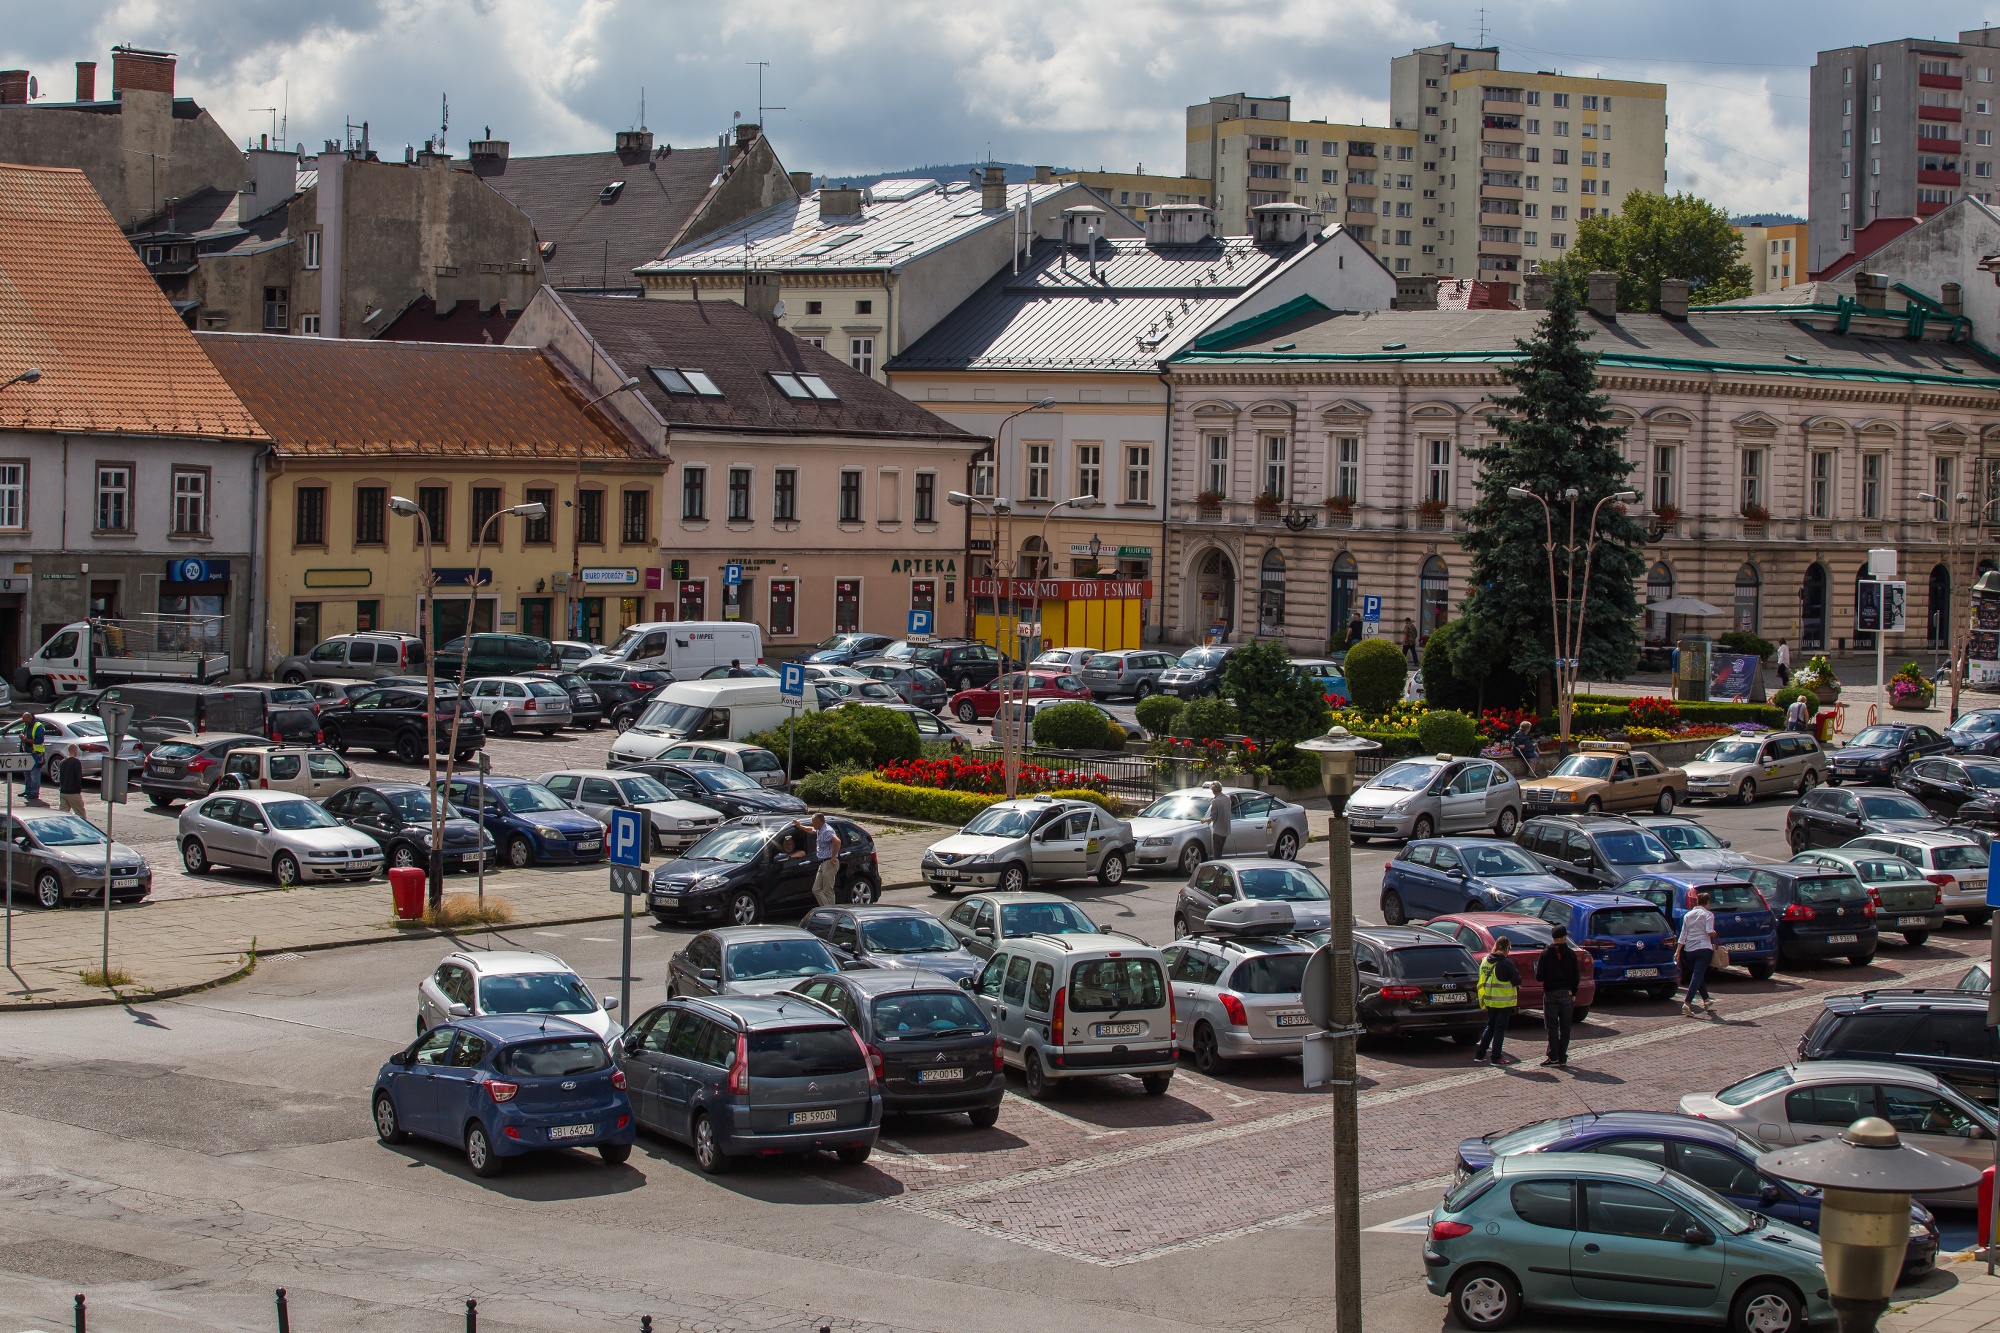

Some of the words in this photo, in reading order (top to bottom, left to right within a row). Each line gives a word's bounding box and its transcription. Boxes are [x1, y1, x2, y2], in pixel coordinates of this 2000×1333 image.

[186, 565, 199, 577] PZU
[891, 558, 956, 573] APTEKA
[584, 572, 600, 581] BIURO
[601, 570, 625, 581] PODRÓŻY
[729, 566, 739, 583] P
[971, 579, 1003, 594] LODY
[1010, 581, 1059, 597] ESKMO
[1072, 583, 1099, 597] LODY
[1104, 582, 1143, 597] ESKIMO
[1367, 597, 1378, 614] P
[912, 612, 927, 631] P
[1020, 626, 1029, 635] WC
[907, 634, 929, 643] Koniec
[785, 666, 800, 690] P
[781, 695, 801, 706] Koniec
[616, 816, 635, 858] P
[1434, 994, 1446, 1002] SZY
[1447, 993, 1467, 1001] 44775
[1282, 1016, 1293, 1025] SB
[1101, 1025, 1114, 1035] SBI
[1117, 1024, 1139, 1034] 05875
[922, 1070, 937, 1080] RPZ
[940, 1068, 962, 1079] 00151
[795, 1112, 807, 1122] SB
[810, 1110, 836, 1121] 5906N
[552, 1127, 566, 1137] SBI
[570, 1124, 594, 1136] 64224
